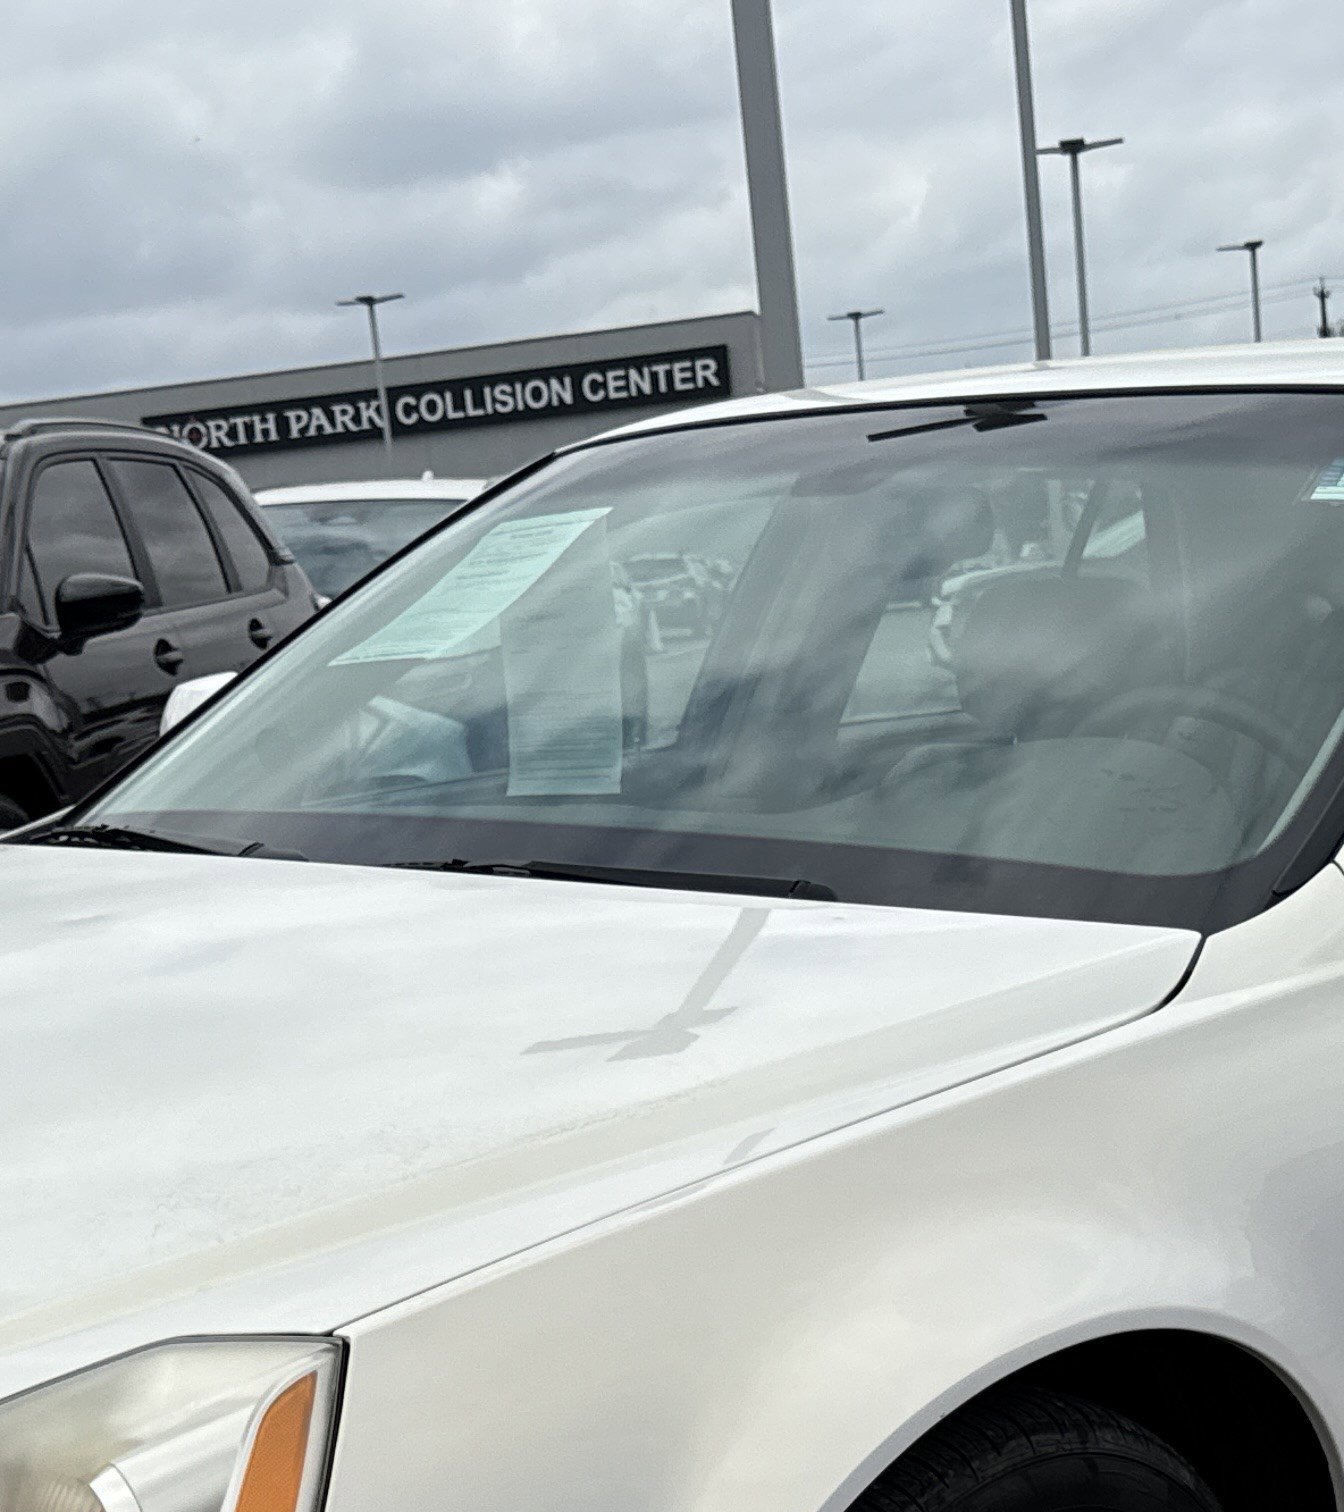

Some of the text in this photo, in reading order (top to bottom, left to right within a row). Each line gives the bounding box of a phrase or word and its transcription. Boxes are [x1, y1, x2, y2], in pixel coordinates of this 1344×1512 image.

[283, 400, 386, 439] PARK
[394, 375, 574, 426] COLLISION
[581, 358, 721, 402] CENTER
